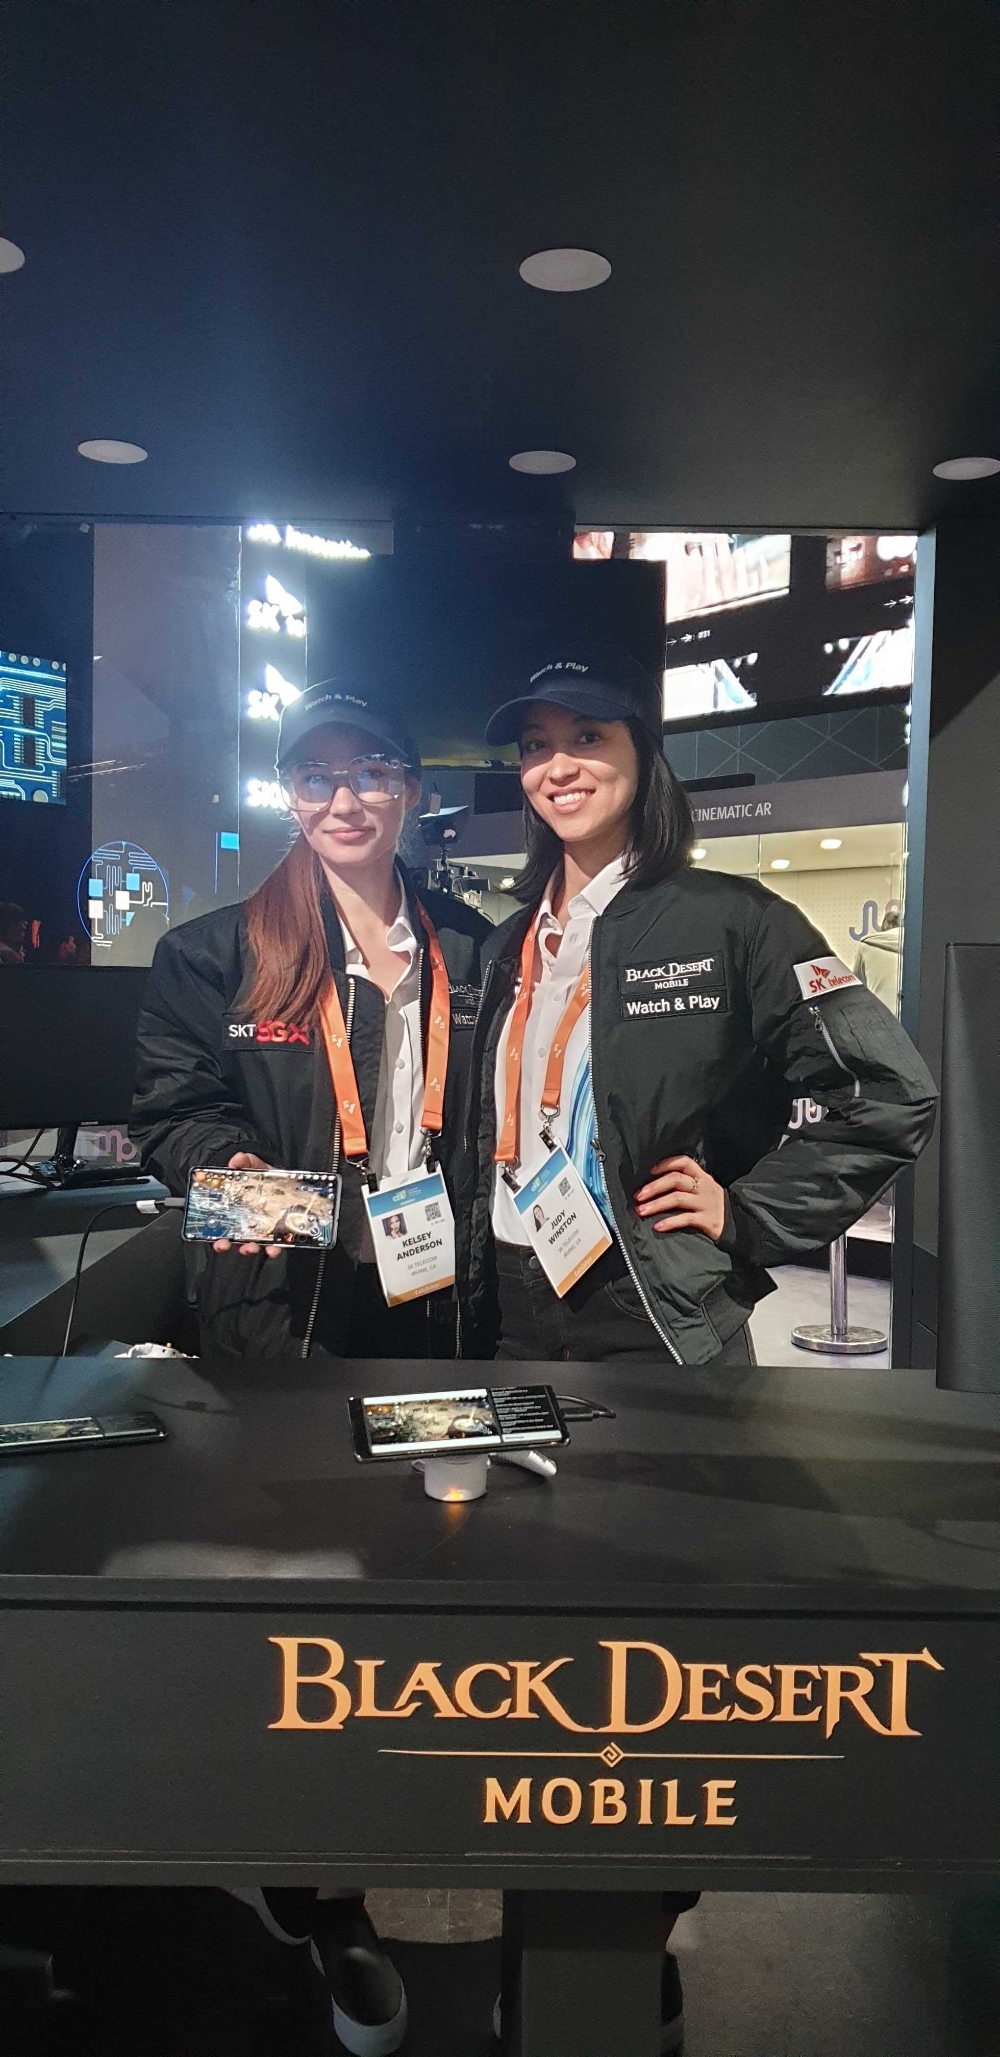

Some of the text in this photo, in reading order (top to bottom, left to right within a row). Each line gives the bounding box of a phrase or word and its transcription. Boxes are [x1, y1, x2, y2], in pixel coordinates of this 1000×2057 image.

[555, 662, 563, 670] &
[565, 662, 589, 673] Play
[304, 694, 331, 711] Watch
[691, 802, 772, 821] CINEMATIC AR
[625, 958, 715, 982] BLACK DESERT
[654, 978, 689, 990] MOBILE
[808, 974, 857, 993] SK telecom
[626, 995, 720, 1015] Watch & Play
[548, 1212, 577, 1245] WINSTON
[551, 1209, 566, 1230] JUDY
[396, 1238, 443, 1261] ANDERSON
[402, 1231, 432, 1248] KELSEY
[267, 1637, 945, 1739] BLACK DESERT
[482, 1777, 738, 1826] MOBILE
